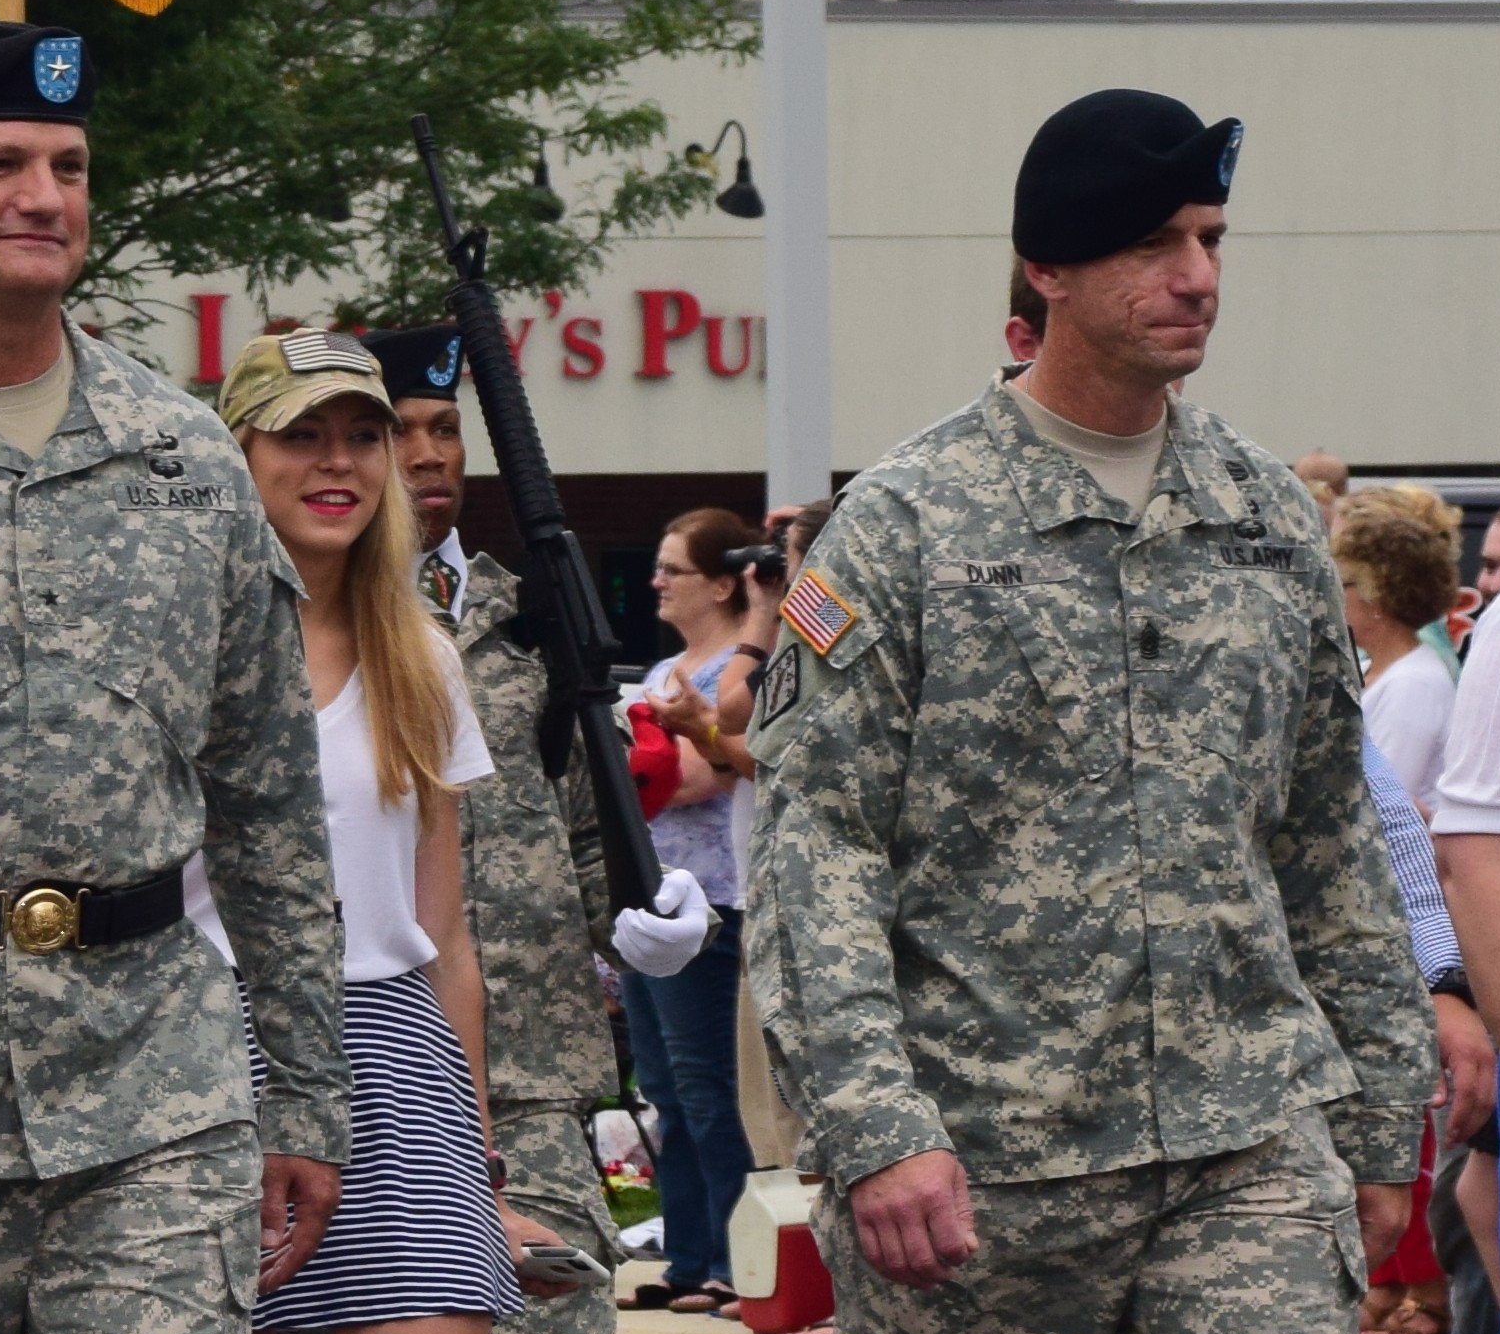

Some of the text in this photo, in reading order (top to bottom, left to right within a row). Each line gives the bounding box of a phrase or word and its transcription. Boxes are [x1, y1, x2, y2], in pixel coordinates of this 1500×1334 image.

[635, 288, 767, 380] PU
[167, 486, 224, 507] ARMY
[1252, 546, 1295, 570] ARMY
[966, 563, 1024, 585] DUNN
